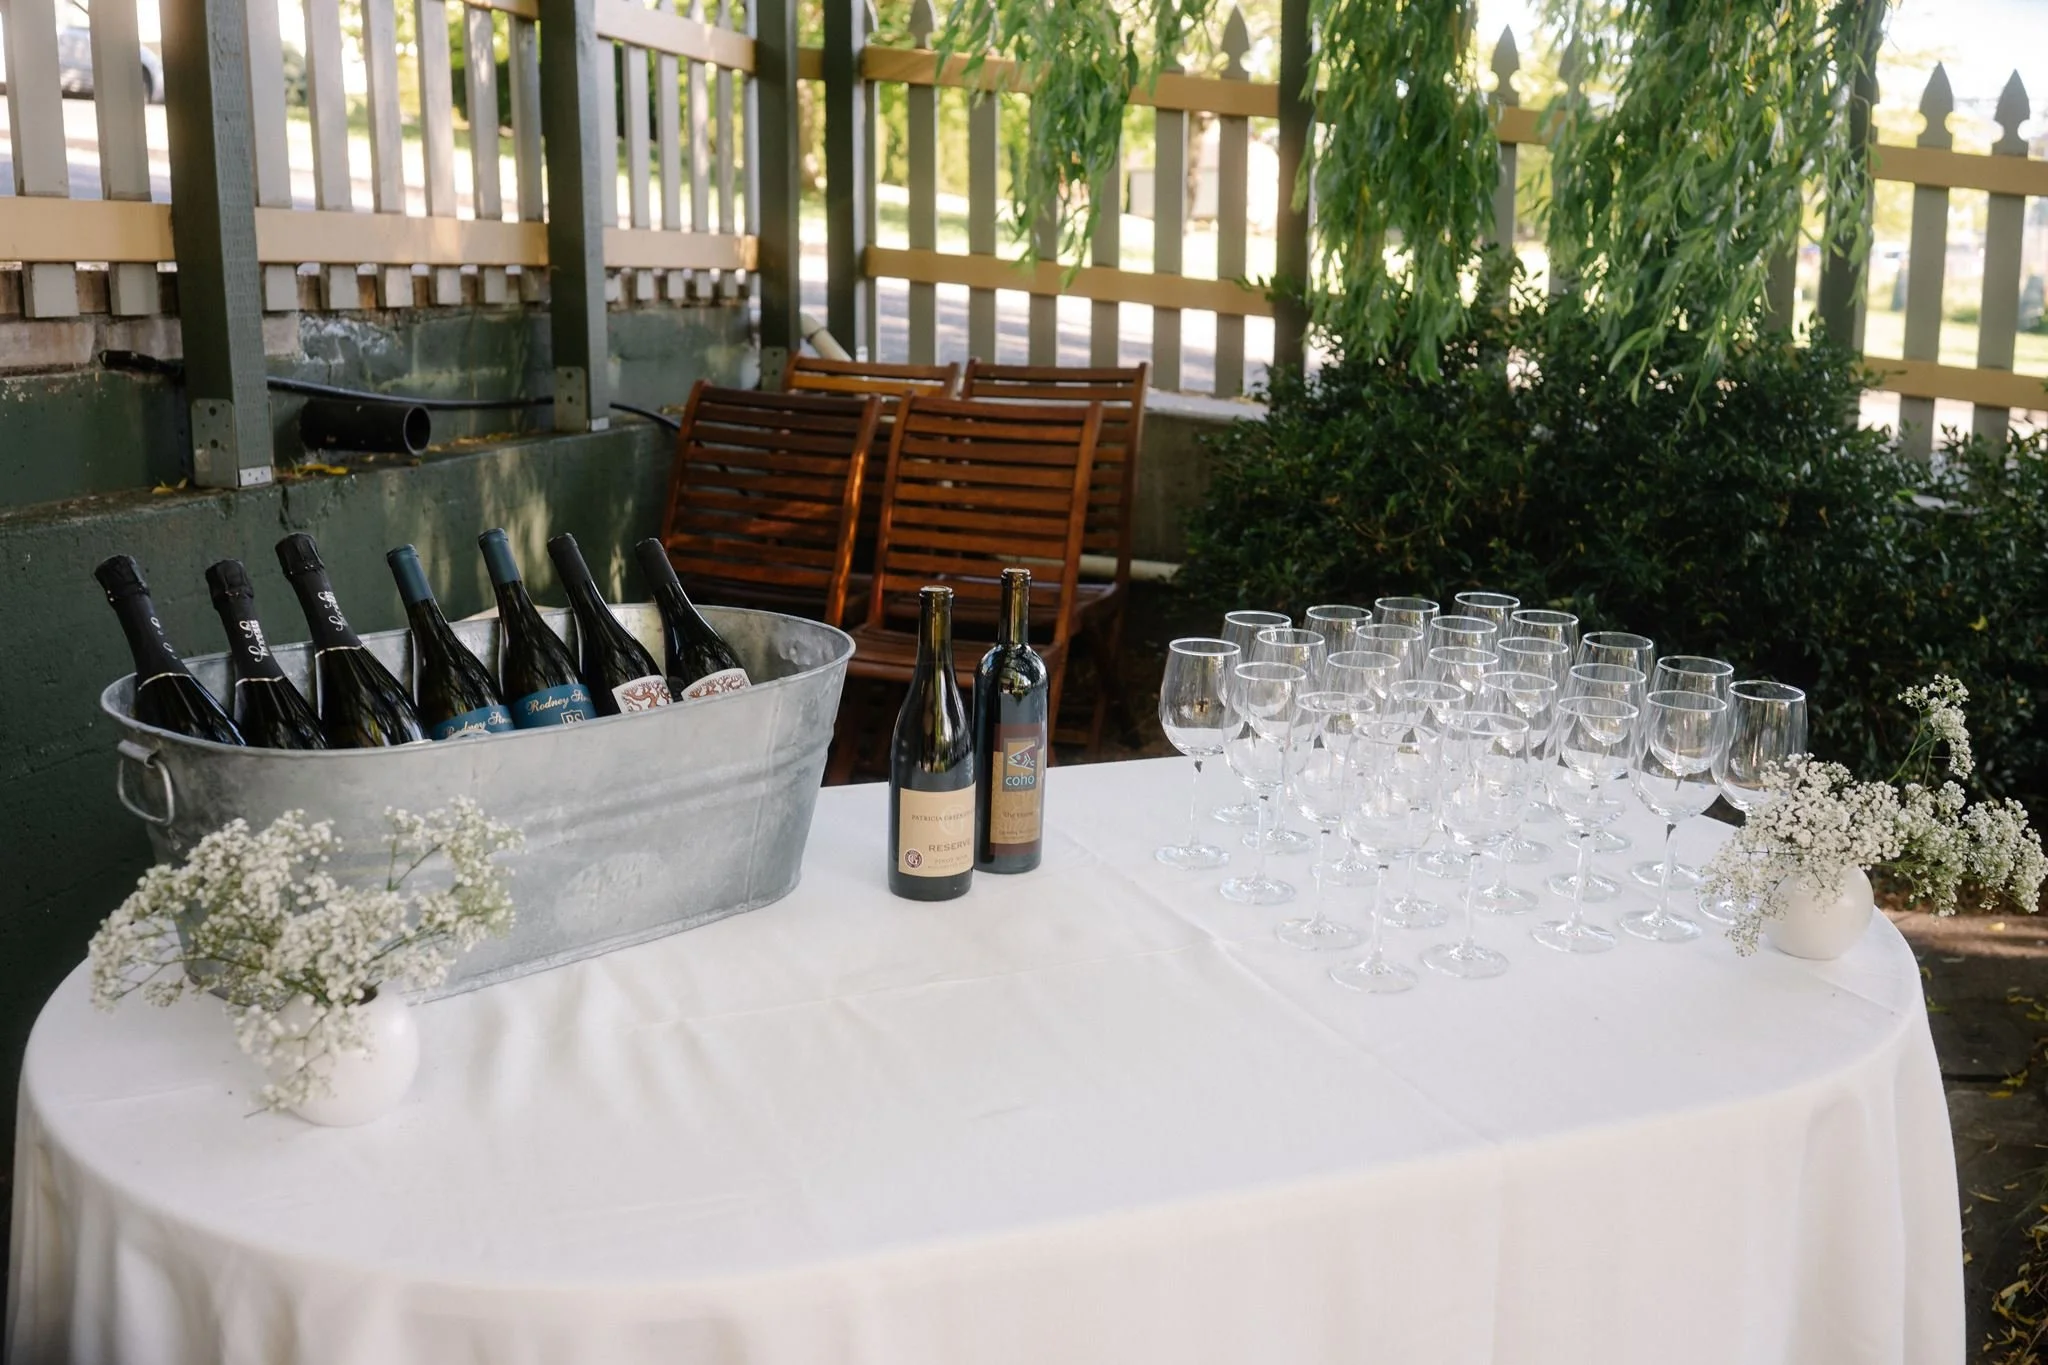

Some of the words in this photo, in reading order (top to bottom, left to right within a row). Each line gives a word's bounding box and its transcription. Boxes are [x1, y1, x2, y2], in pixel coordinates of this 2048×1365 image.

[527, 696, 569, 715] Rodney
[1005, 772, 1035, 786] coho
[911, 814, 943, 822] PATRICIA
[928, 838, 970, 852] RESERVE
